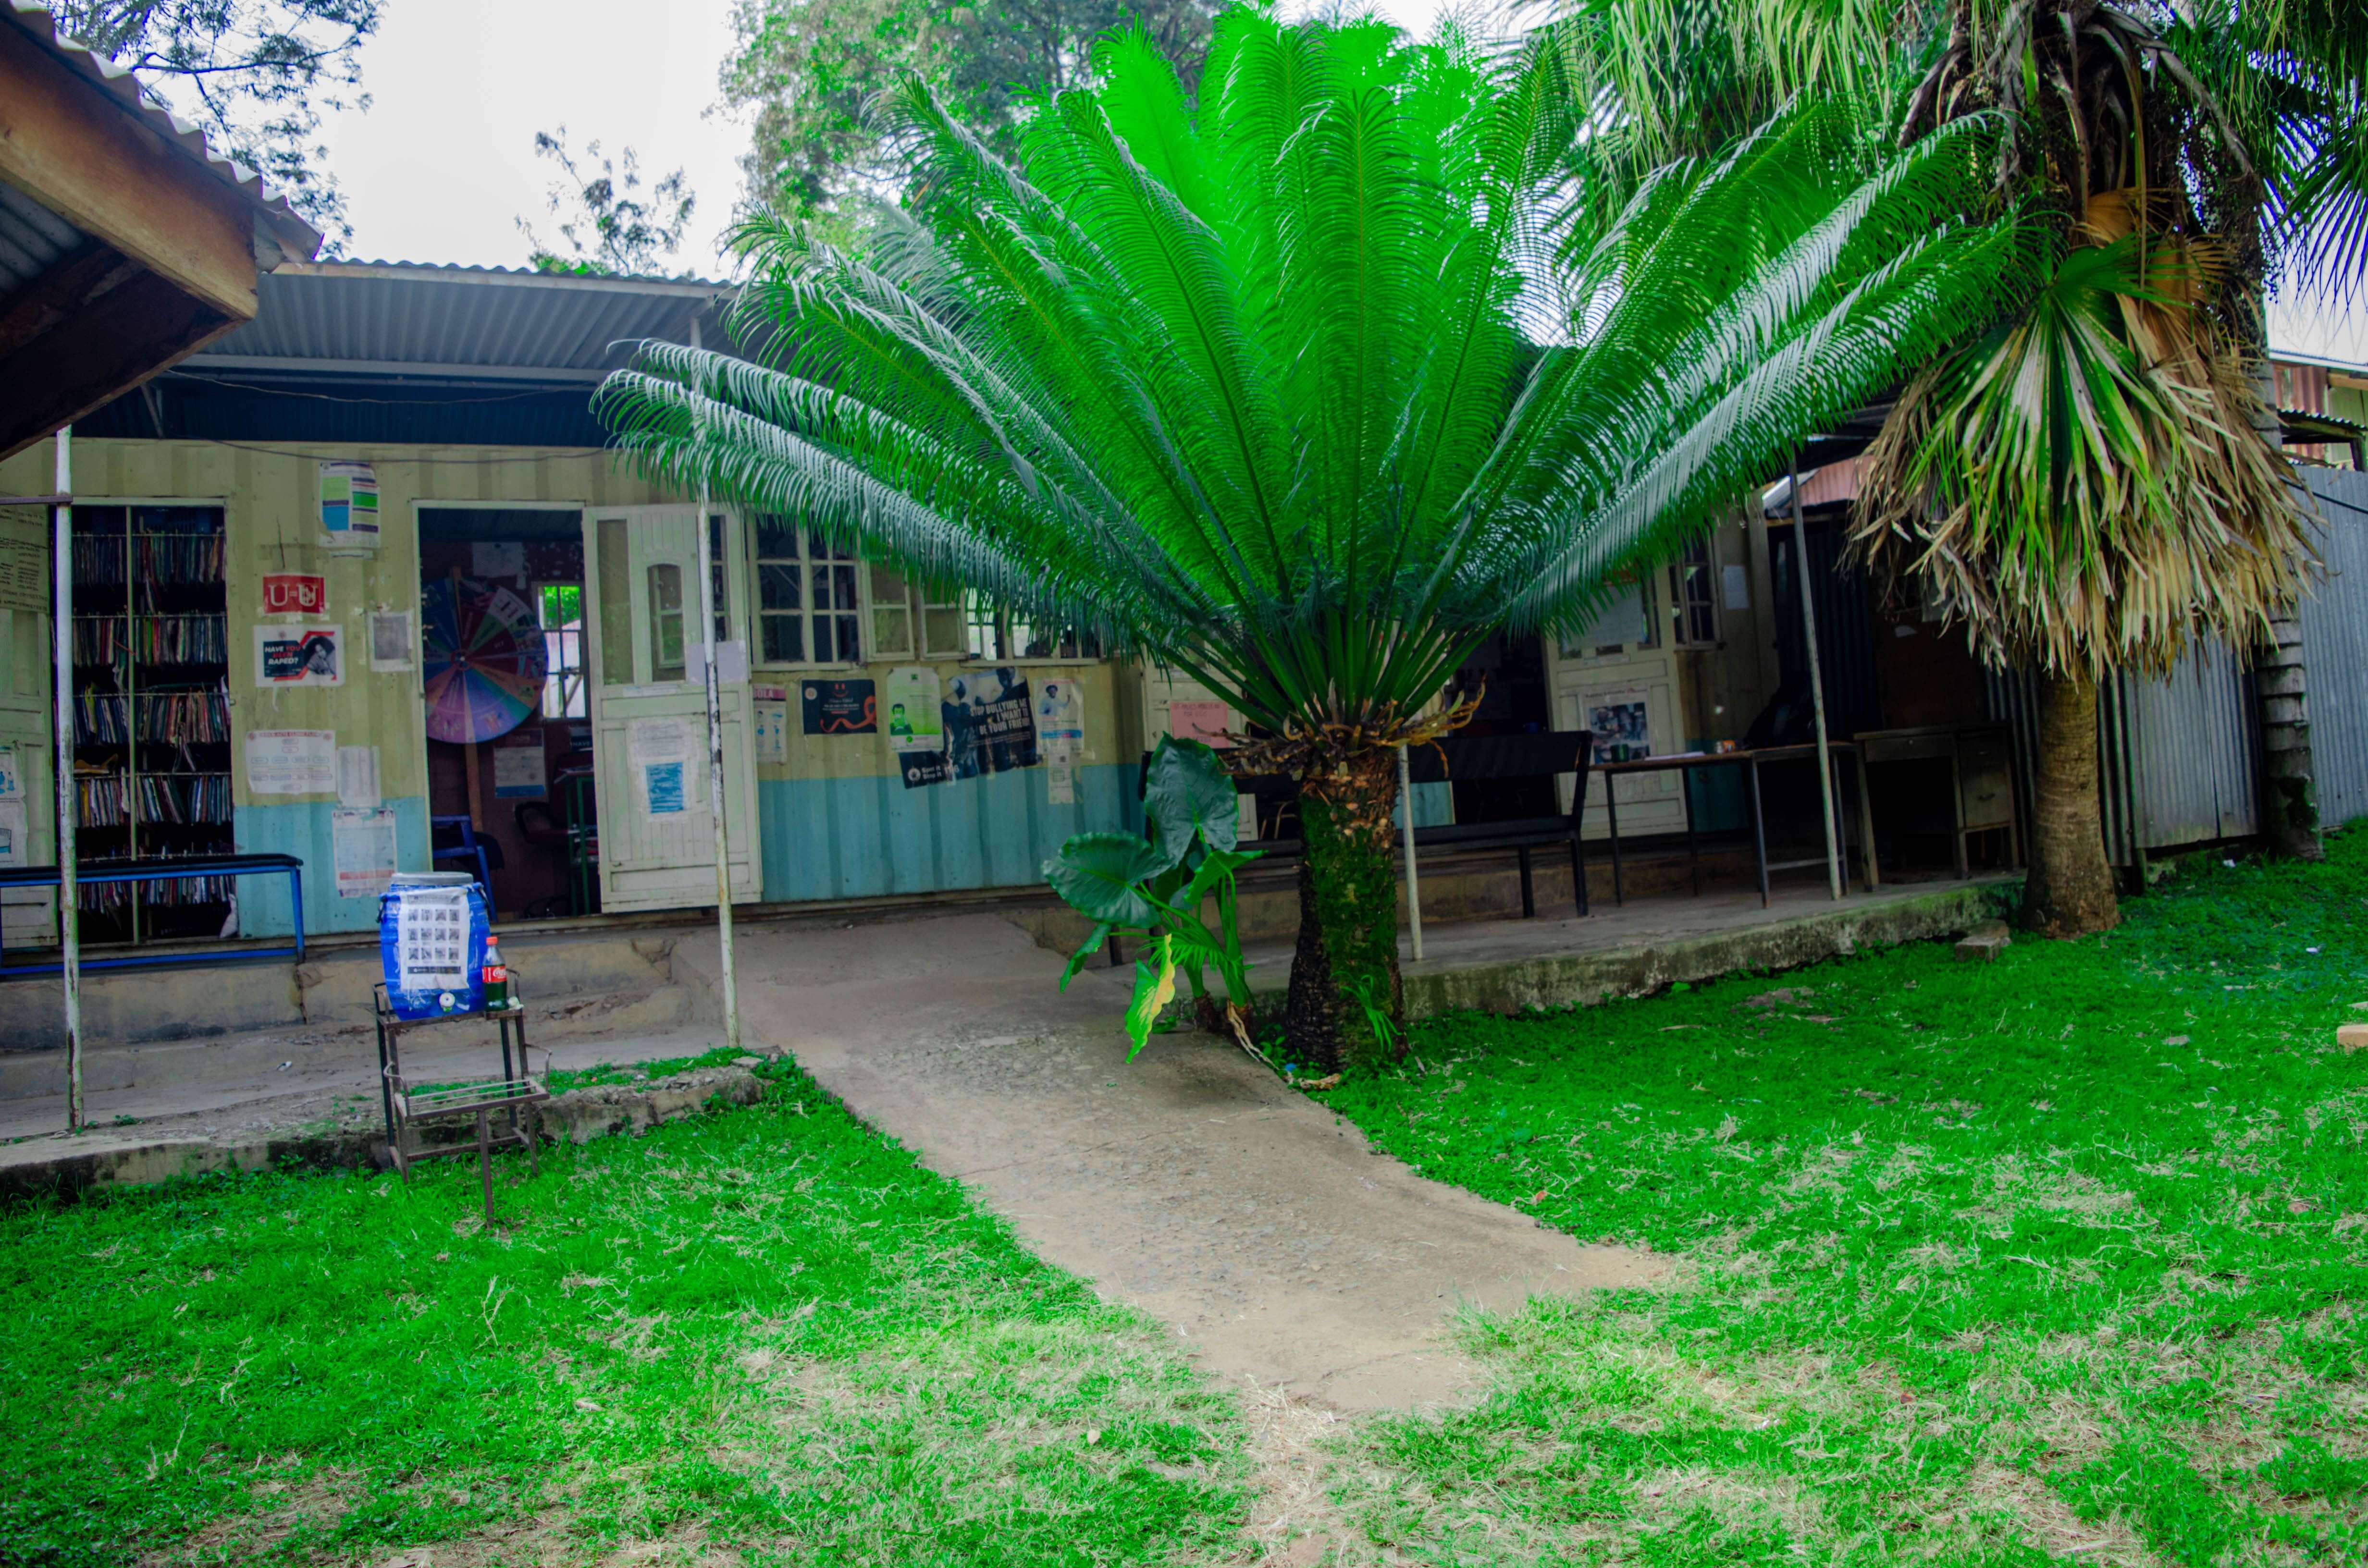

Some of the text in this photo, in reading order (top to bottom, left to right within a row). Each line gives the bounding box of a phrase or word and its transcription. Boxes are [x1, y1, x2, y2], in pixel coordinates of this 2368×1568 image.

[971, 698, 1027, 716] STOP BULLYING ME
[1000, 708, 1022, 722] WANT
[979, 725, 987, 735] BE
[988, 722, 1008, 734] YOUR
